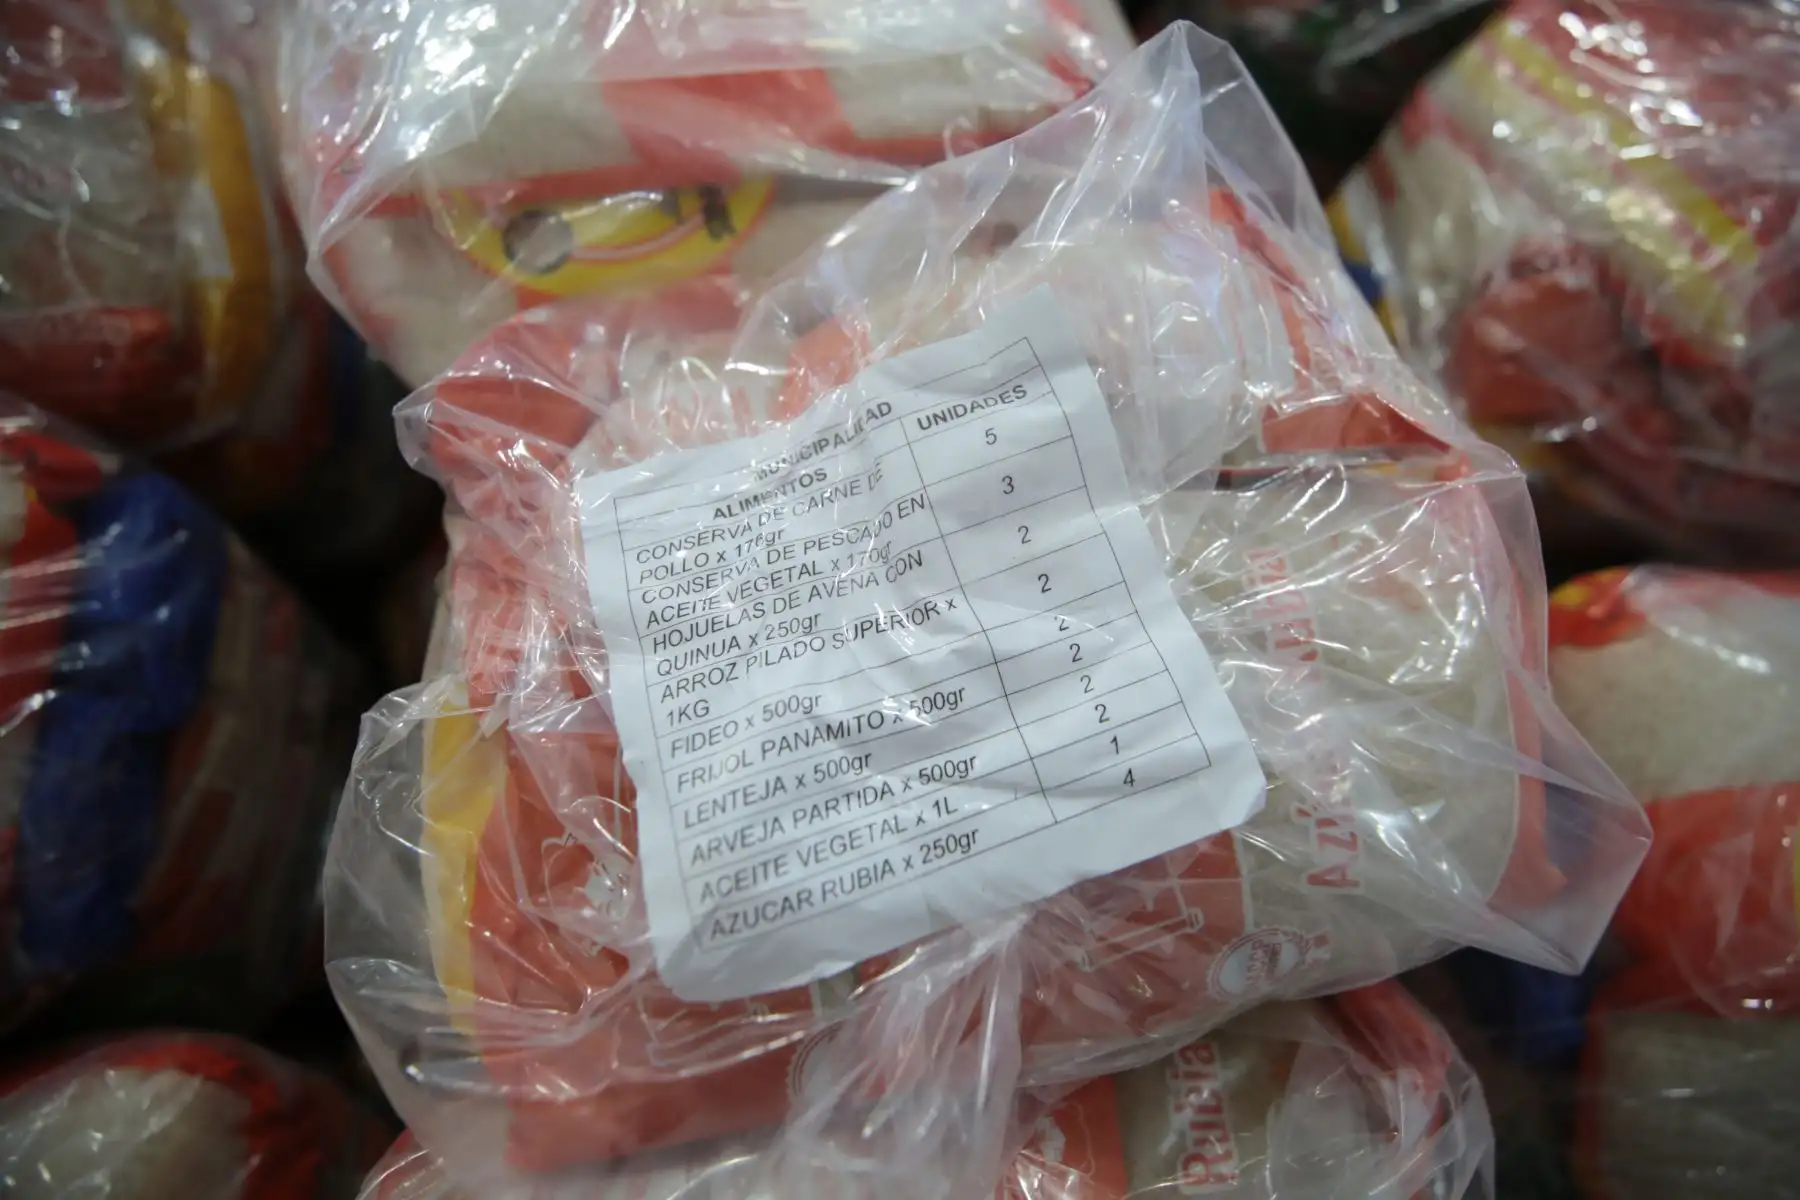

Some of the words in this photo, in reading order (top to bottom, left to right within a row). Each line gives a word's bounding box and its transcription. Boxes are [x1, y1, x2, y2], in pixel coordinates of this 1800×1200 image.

[917, 384, 1028, 431] UNIDADES
[985, 428, 997, 445] 5
[713, 467, 827, 520] ALIMENTOS
[1001, 475, 1015, 495] 3
[636, 522, 752, 564] CONSERVA
[759, 507, 785, 527] DE
[793, 480, 862, 516] CARNE
[1017, 525, 1031, 544] 2
[640, 552, 709, 584] POLLO
[716, 551, 726, 563] x
[642, 556, 759, 604] CONSERVA
[767, 544, 796, 565] DE
[897, 494, 925, 519] EN
[647, 594, 720, 629] ACEITE
[727, 561, 823, 605] VEGETAL
[831, 559, 840, 572] x
[847, 541, 892, 567] 170gr
[653, 602, 765, 654] HOJUELAS
[773, 591, 801, 614] DE
[808, 572, 879, 602] AVENA
[886, 550, 923, 583] CON
[1038, 573, 1052, 593] 2
[657, 635, 740, 676] QUINUA
[749, 633, 758, 648] x
[765, 613, 821, 640] 250gr
[1054, 614, 1069, 632] 2
[661, 662, 738, 703] ARROZ
[747, 636, 825, 674] PILADO
[832, 600, 940, 649] SUPERIOR
[945, 599, 957, 611] x
[1069, 643, 1083, 662] 2
[1080, 674, 1094, 693] 2
[667, 699, 710, 727] 1KG
[671, 721, 738, 759] FIDEO
[745, 715, 754, 730] x
[762, 695, 822, 722] 500gr
[1095, 704, 1110, 723] 2
[677, 749, 754, 793] FRIJOL
[762, 710, 884, 760] PANAMITO
[910, 687, 965, 718] 500gr
[1110, 735, 1119, 754] 1
[684, 776, 788, 828] LENTEJA
[795, 773, 805, 789] x
[813, 752, 872, 784] 500gr
[1123, 768, 1136, 787] 4
[691, 816, 786, 867] ARVEJA
[792, 781, 894, 829] PARTIDA
[903, 778, 912, 793] x
[919, 756, 976, 785] 500gr
[701, 853, 791, 904] ACEITE
[796, 814, 908, 867] VEGETAL
[915, 810, 926, 826] x
[933, 796, 958, 817] 1L
[711, 888, 815, 941] AZUCAR
[821, 859, 895, 904] RUBIA
[902, 855, 914, 872] x
[920, 829, 979, 864] 250gr
[1171, 1043, 1239, 1186] Rubia
